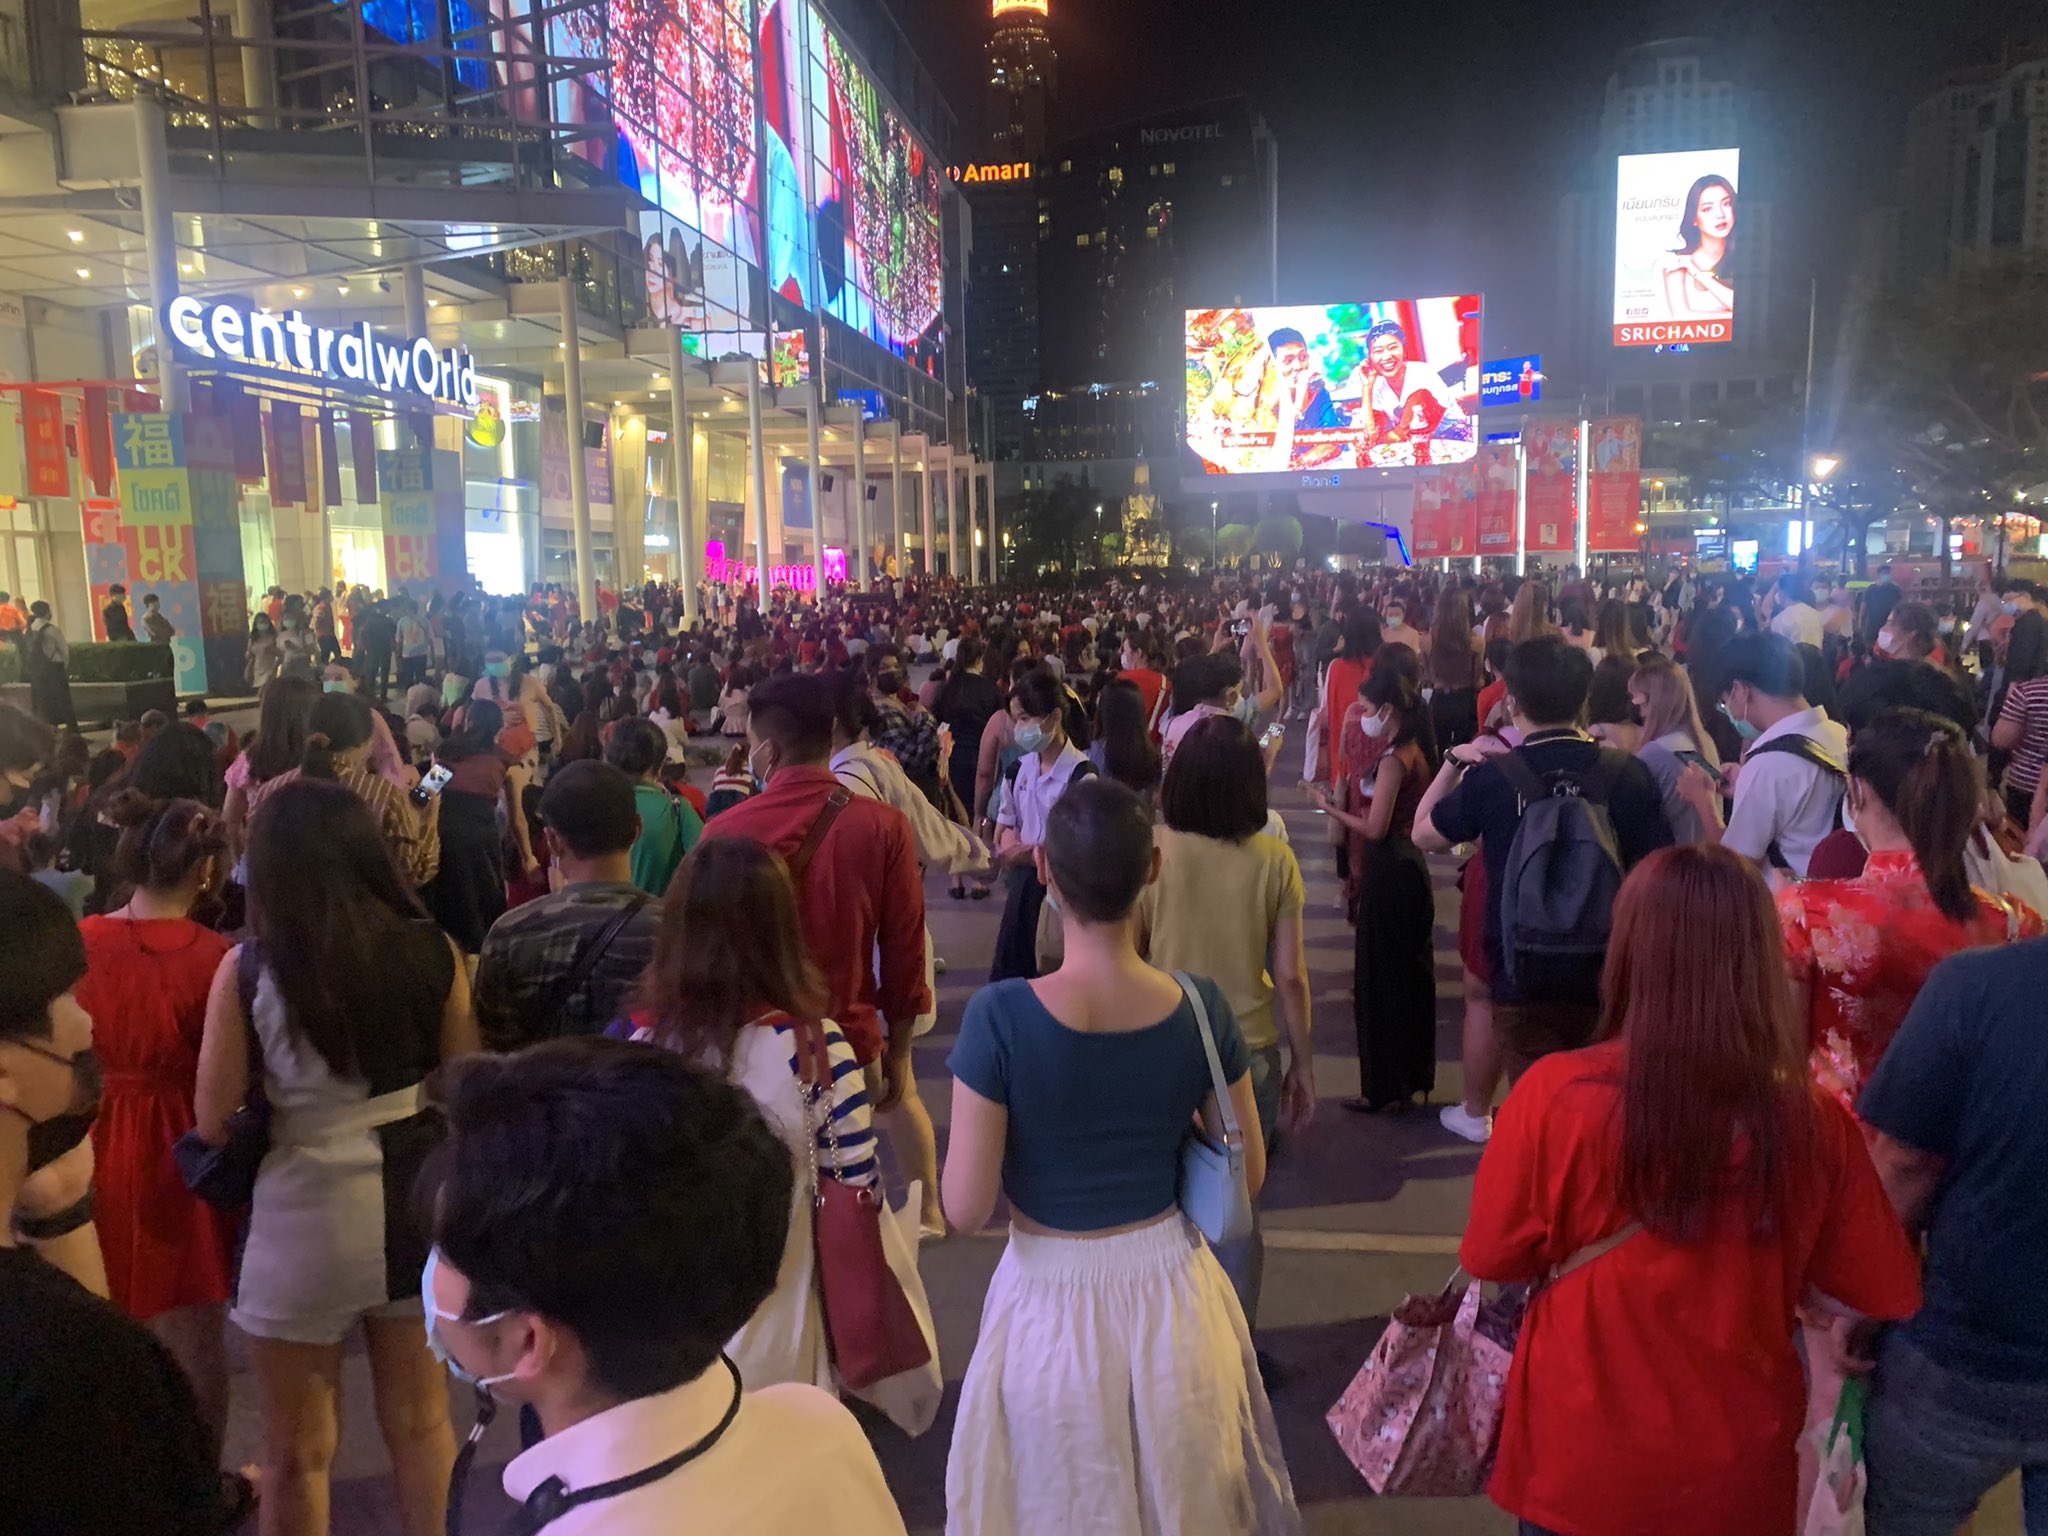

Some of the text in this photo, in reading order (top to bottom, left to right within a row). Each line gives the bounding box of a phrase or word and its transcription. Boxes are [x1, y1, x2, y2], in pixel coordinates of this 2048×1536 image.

[1141, 122, 1224, 144] NOVOTEL
[963, 162, 1030, 182] Amari
[1621, 324, 1725, 341] SRICHAND
[123, 414, 174, 466] 福
[386, 453, 422, 490] 福
[206, 584, 242, 632] 福
